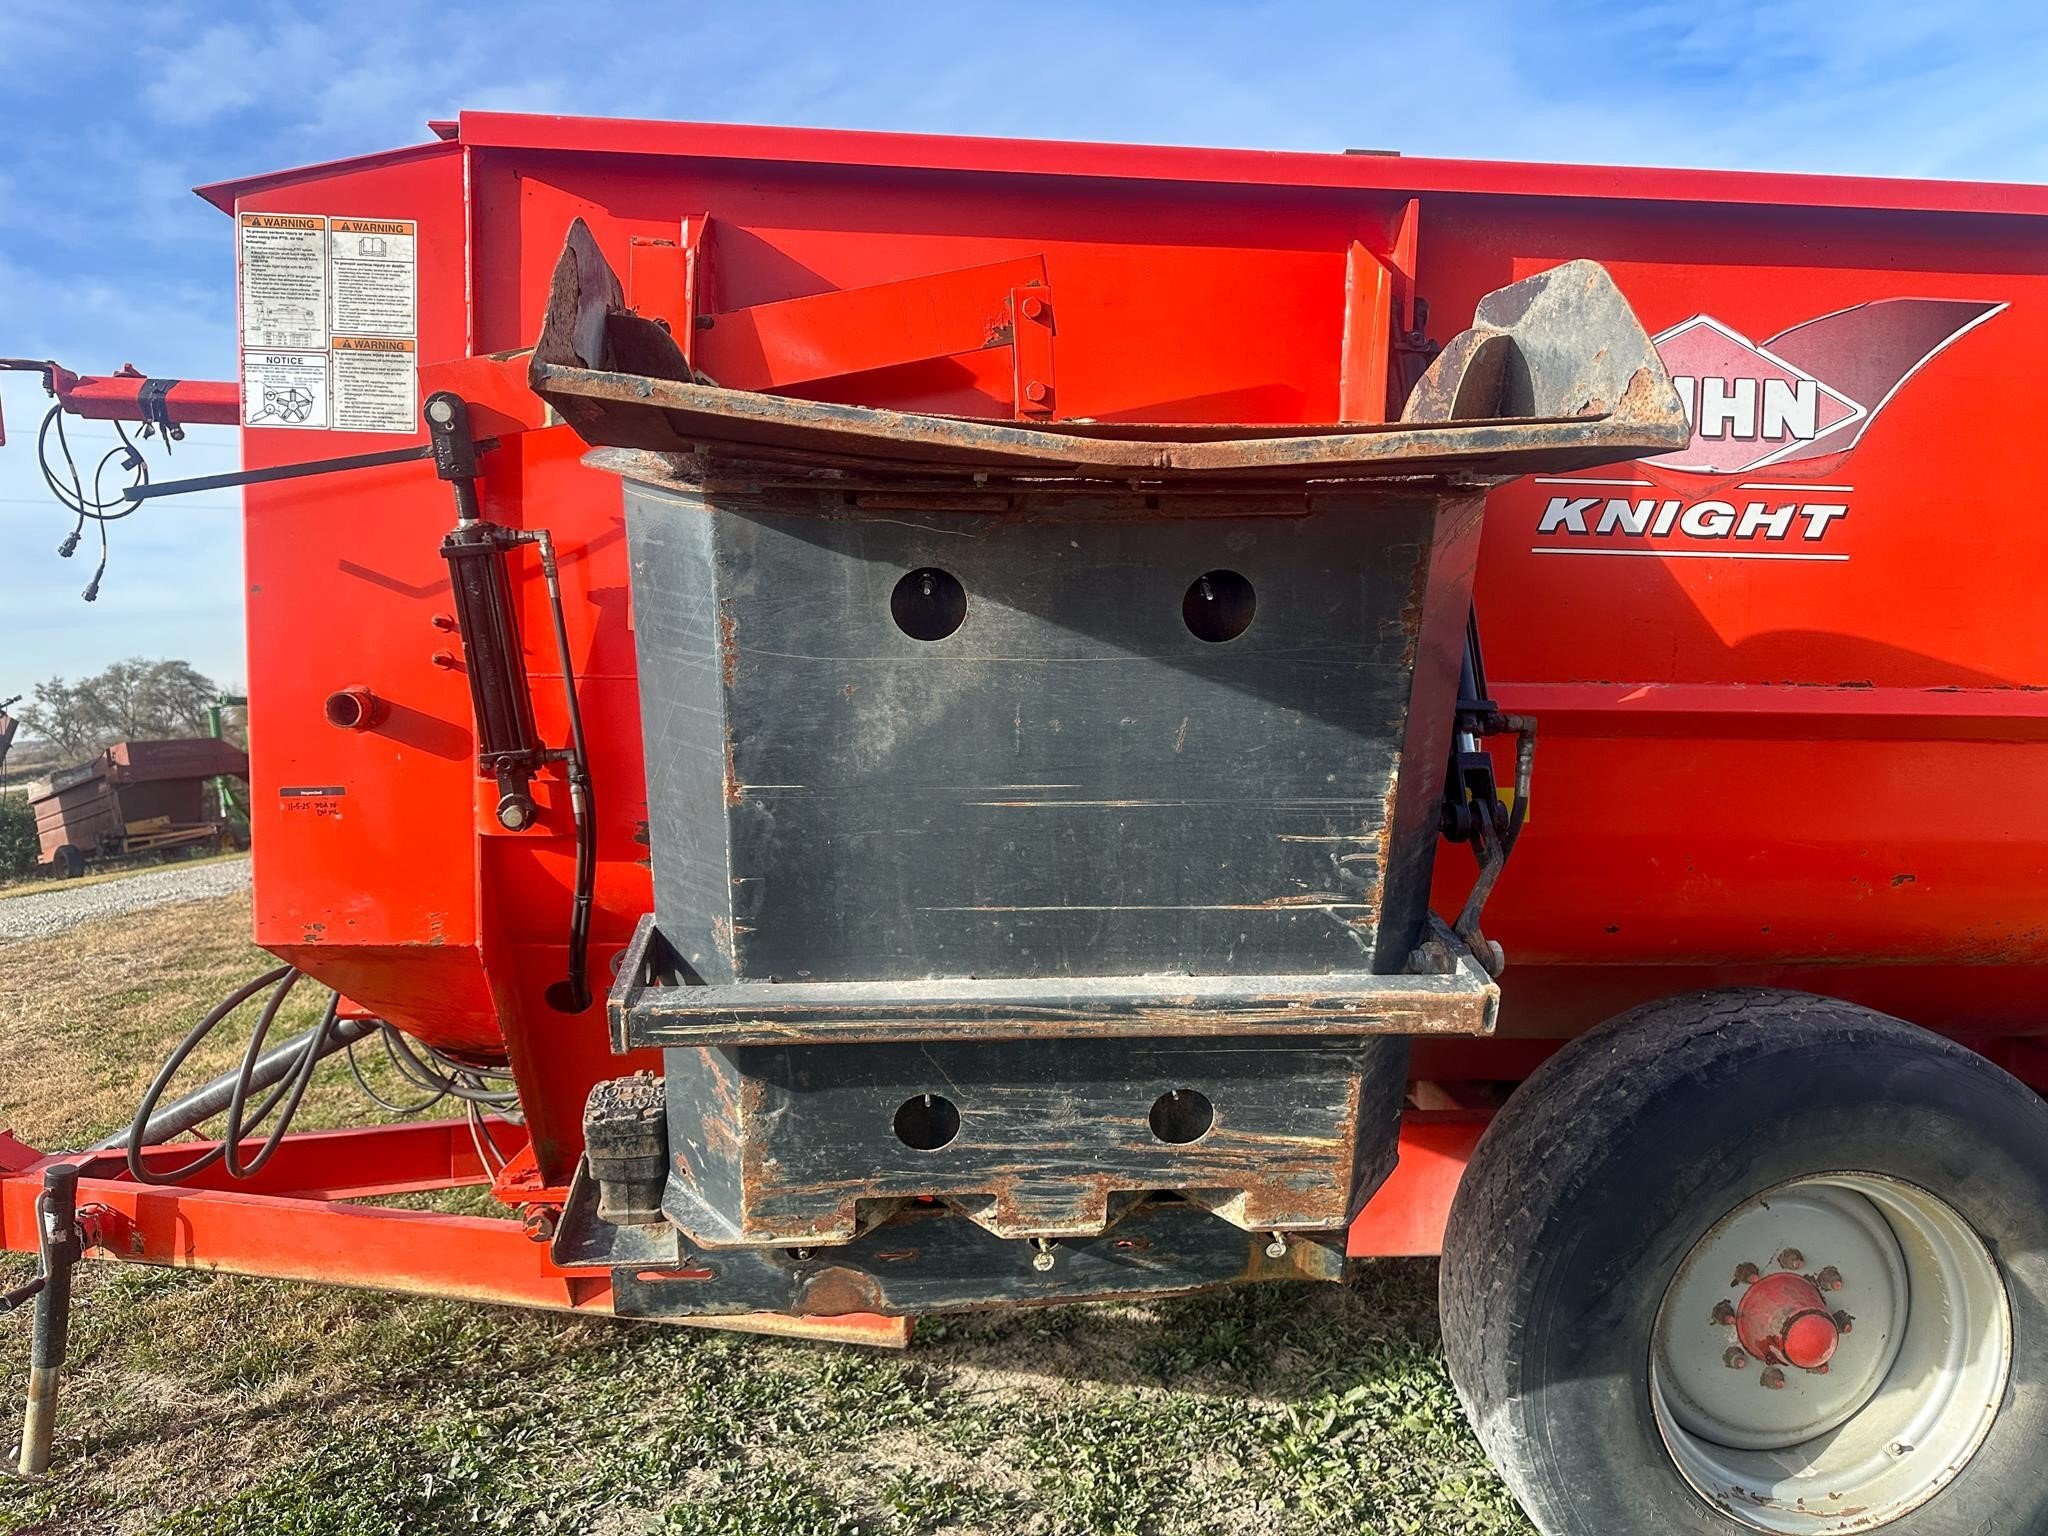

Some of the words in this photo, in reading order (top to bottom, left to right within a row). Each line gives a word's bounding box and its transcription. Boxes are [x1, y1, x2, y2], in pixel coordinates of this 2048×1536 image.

[264, 218, 314, 228] WARNING
[353, 223, 403, 233] WARNING
[354, 340, 404, 350] WARNING
[266, 356, 304, 365] NOTICE
[1536, 496, 1849, 541] KNIGHT
